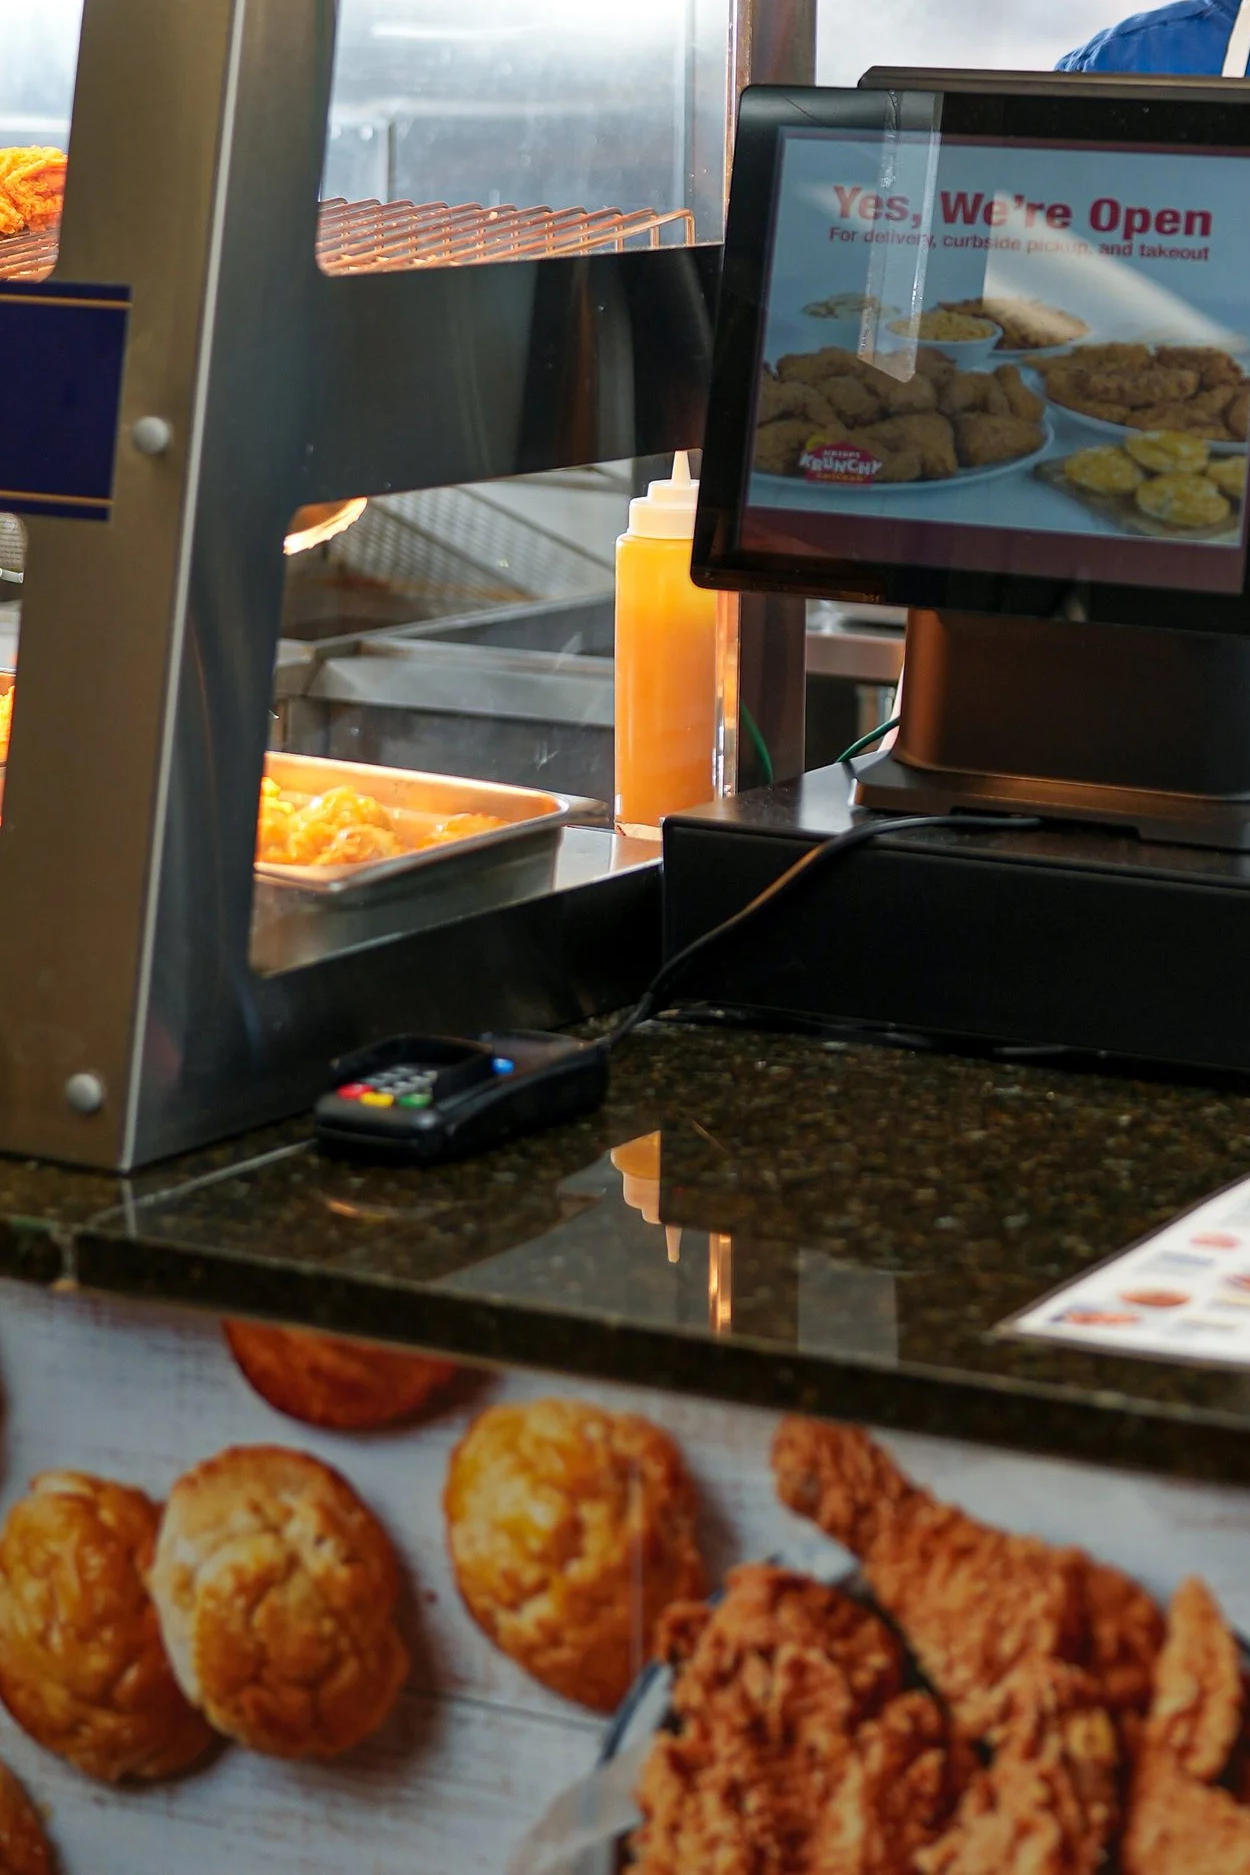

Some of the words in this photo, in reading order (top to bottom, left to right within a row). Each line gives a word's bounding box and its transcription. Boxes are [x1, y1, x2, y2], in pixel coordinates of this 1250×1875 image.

[833, 184, 922, 228] Yes,
[940, 191, 1072, 230] We're
[1090, 197, 1212, 242] Open
[829, 227, 859, 243] For
[864, 228, 937, 250] delivery,
[943, 233, 1020, 252] curbside
[1099, 241, 1132, 257] and
[1139, 244, 1210, 262] takeout
[799, 453, 883, 474] KRUNCHY
